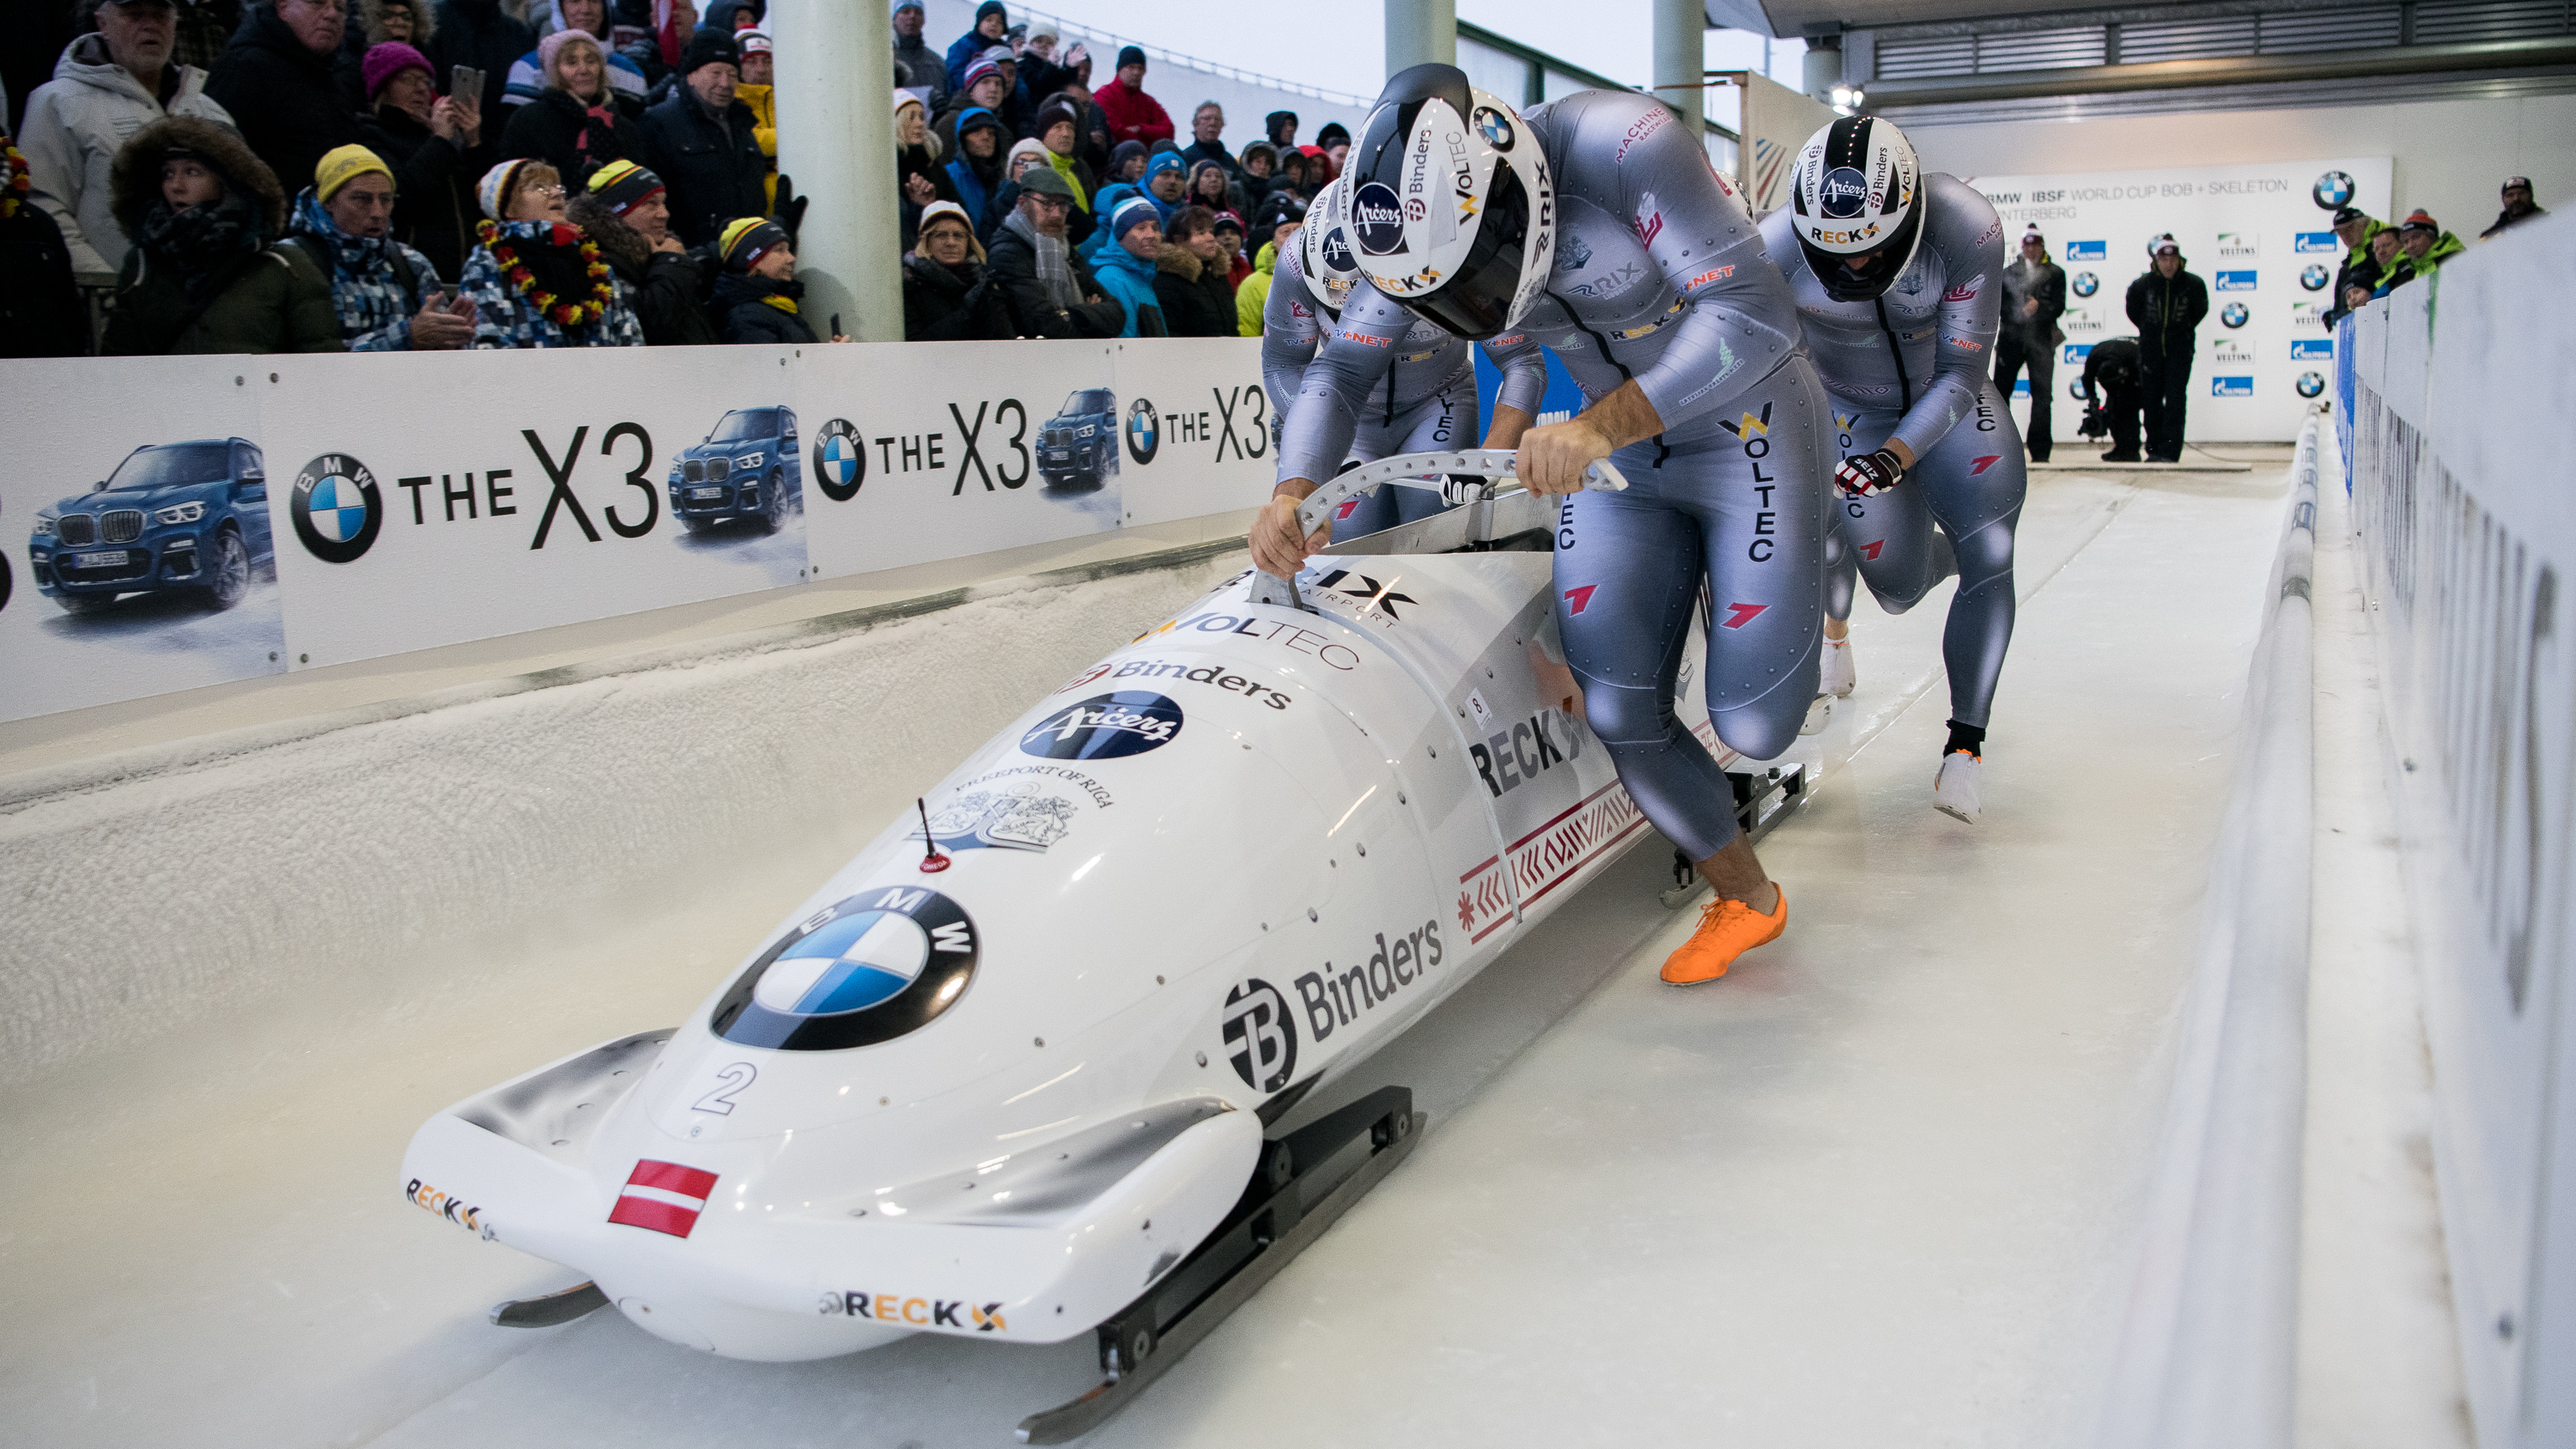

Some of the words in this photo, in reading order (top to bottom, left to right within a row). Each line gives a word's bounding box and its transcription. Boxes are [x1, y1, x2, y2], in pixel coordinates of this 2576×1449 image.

[1616, 107, 1665, 164] MACHINE
[1409, 129, 1432, 195] Binders
[1806, 160, 1818, 205] Binders
[1873, 147, 1888, 190] Binders
[2032, 190, 2067, 203] IBSF
[2070, 186, 2123, 201] WORLD
[2127, 184, 2158, 199] CUP
[2161, 182, 2194, 198] BOB
[2208, 179, 2288, 195] SKELETON
[1310, 210, 1322, 253] Binders
[1811, 226, 1864, 245] RECK
[2221, 247, 2257, 256] VELTINS
[1609, 314, 1671, 341] RECK
[2068, 321, 2102, 331] VELTINS
[2215, 353, 2252, 362] VELTINS
[1165, 411, 1212, 444] THE
[1212, 384, 1268, 466] X3
[875, 432, 945, 476] THE
[948, 399, 1031, 497] X3
[1855, 457, 1880, 482] SEIZ
[398, 469, 518, 526] THE
[521, 422, 660, 551] X3
[1716, 400, 1777, 563] WOLTEC
[1300, 588, 1396, 629] AIRPORT
[1112, 661, 1292, 711] Binders
[1471, 697, 1484, 715] 8
[1468, 709, 1564, 799] RECK
[955, 764, 1061, 795] FREEPORT
[1057, 767, 1087, 782] OF
[1078, 776, 1116, 810] RIGA
[1293, 918, 1444, 1044] Binders
[690, 1062, 758, 1117] 2
[406, 1178, 464, 1226] RECK
[844, 1290, 965, 1329] RECK
